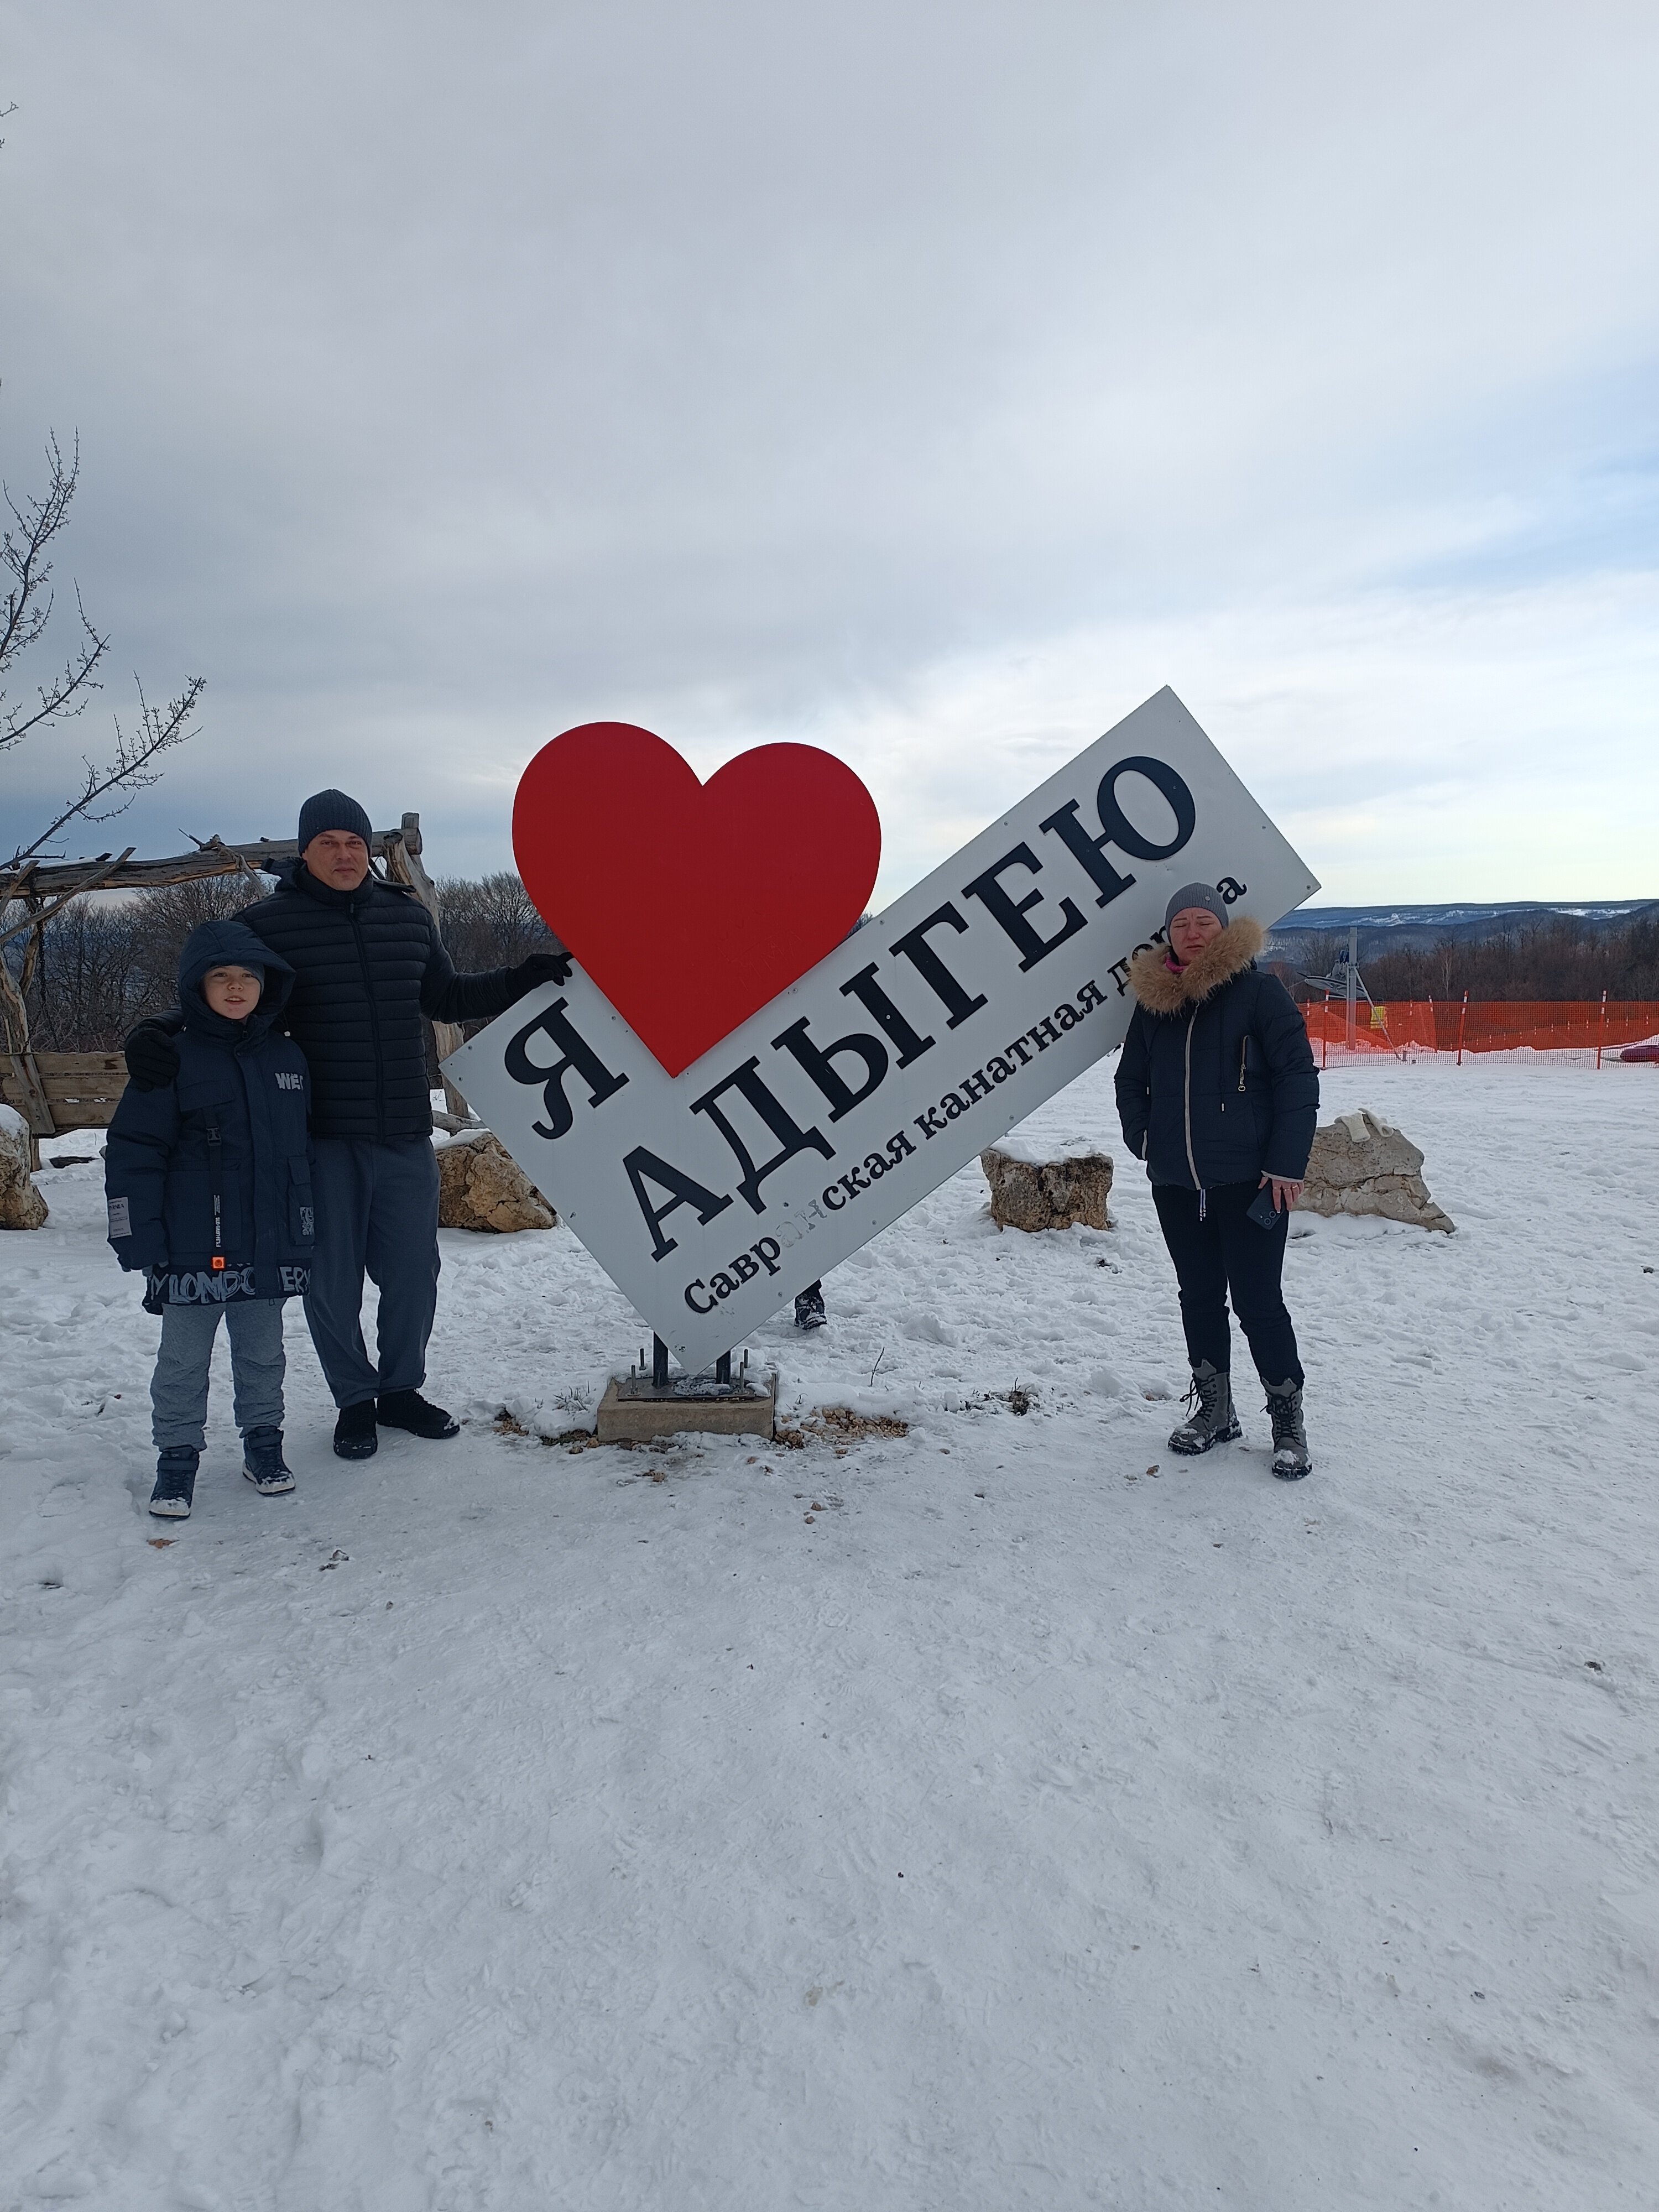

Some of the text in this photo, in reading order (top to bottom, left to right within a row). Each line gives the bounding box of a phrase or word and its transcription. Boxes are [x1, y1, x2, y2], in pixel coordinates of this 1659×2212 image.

[504, 996, 630, 1140] Я
[622, 756, 1196, 1263] АДЫГЕЮ
[913, 979, 1109, 1140] канатная
